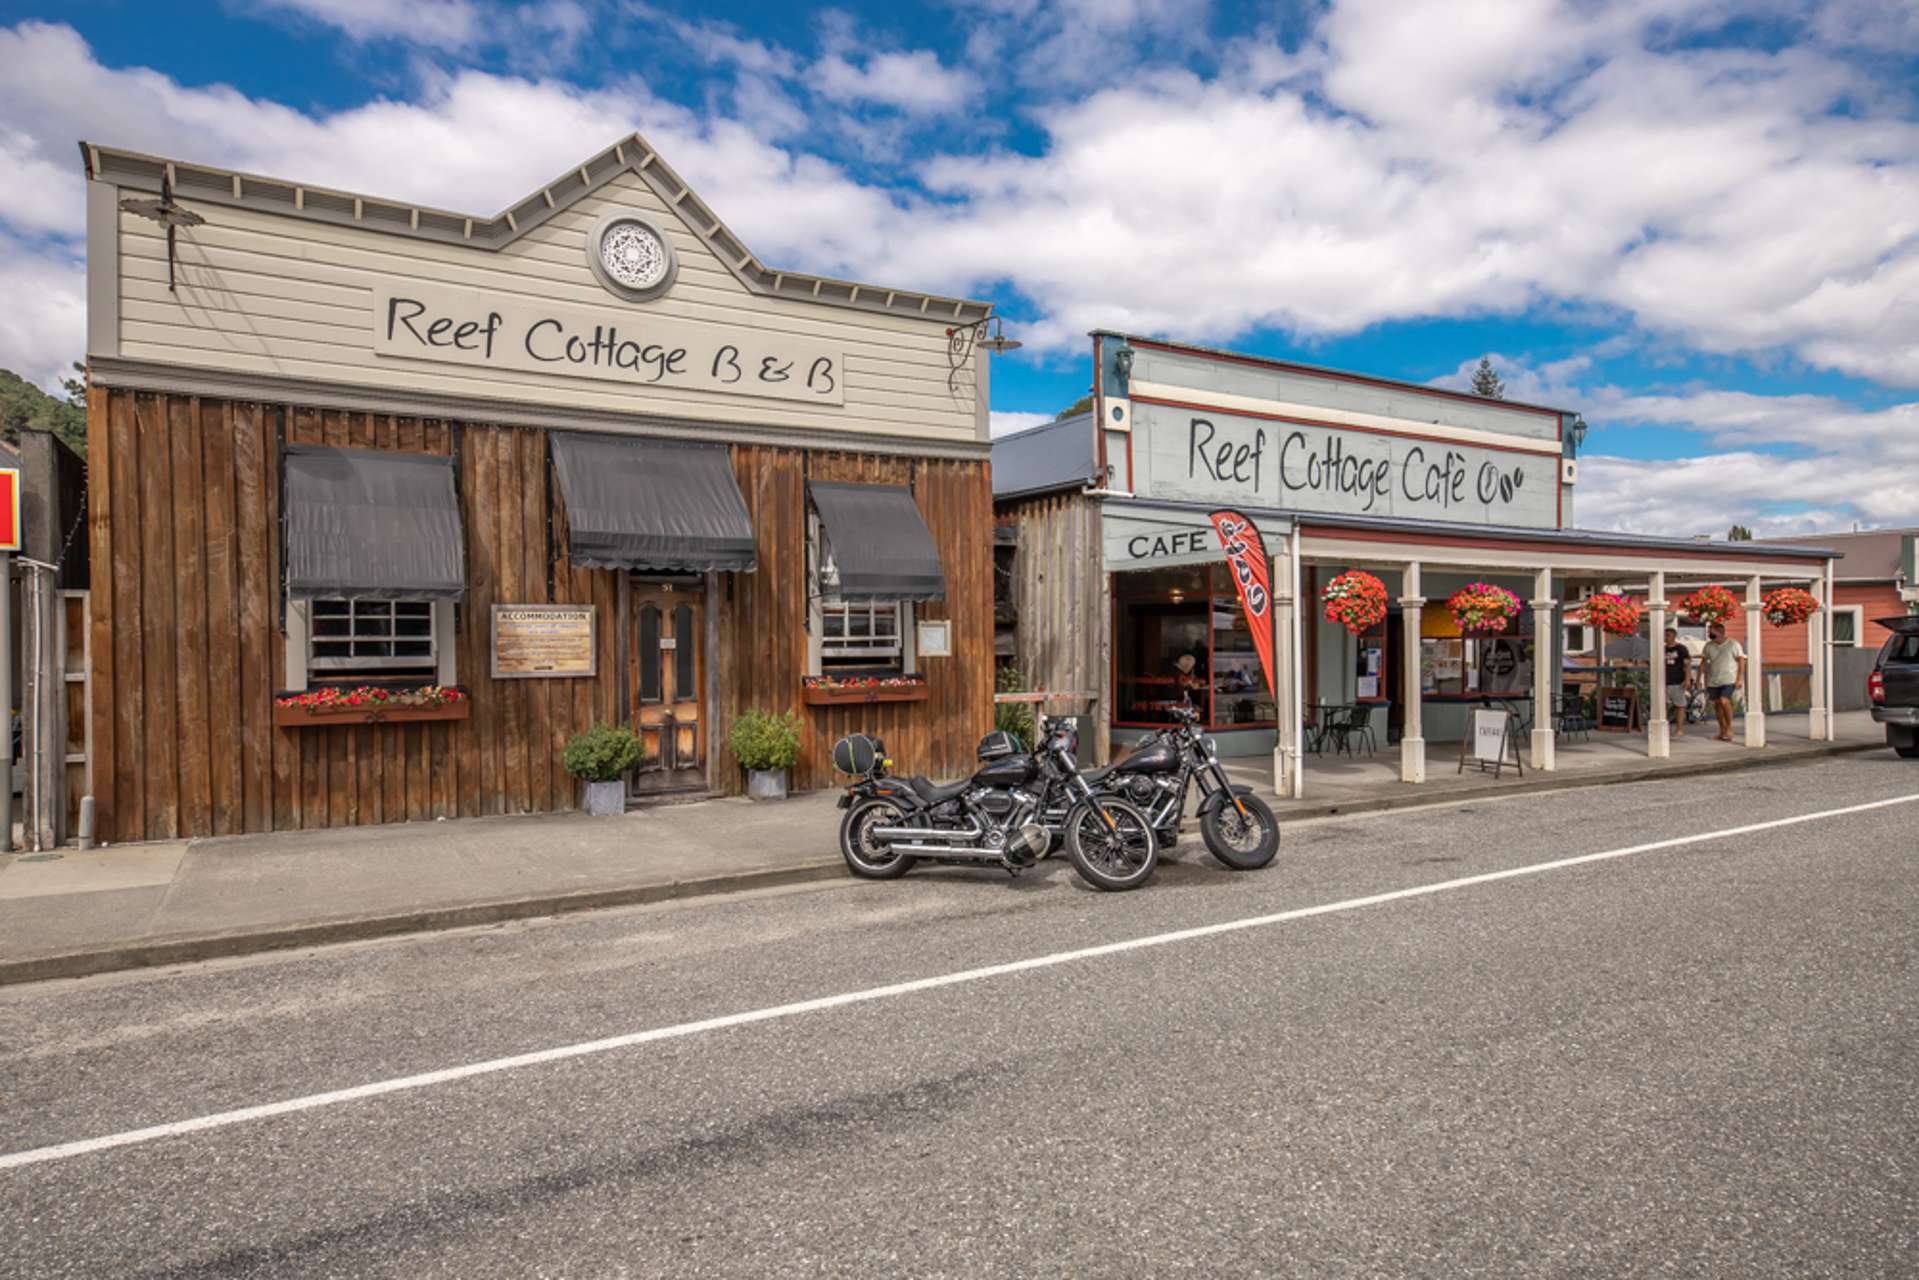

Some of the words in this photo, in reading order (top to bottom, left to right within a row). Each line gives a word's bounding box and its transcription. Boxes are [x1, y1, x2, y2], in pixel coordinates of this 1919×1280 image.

[387, 296, 502, 359] Reef
[525, 318, 687, 382] Cottage
[712, 344, 742, 384] B
[758, 356, 795, 383] &
[807, 356, 835, 394] B
[1188, 418, 1266, 493] Reef
[1280, 431, 1391, 511] Cottage
[1128, 531, 1208, 559] CAFE
[501, 611, 587, 620] ACCOMMODATION
